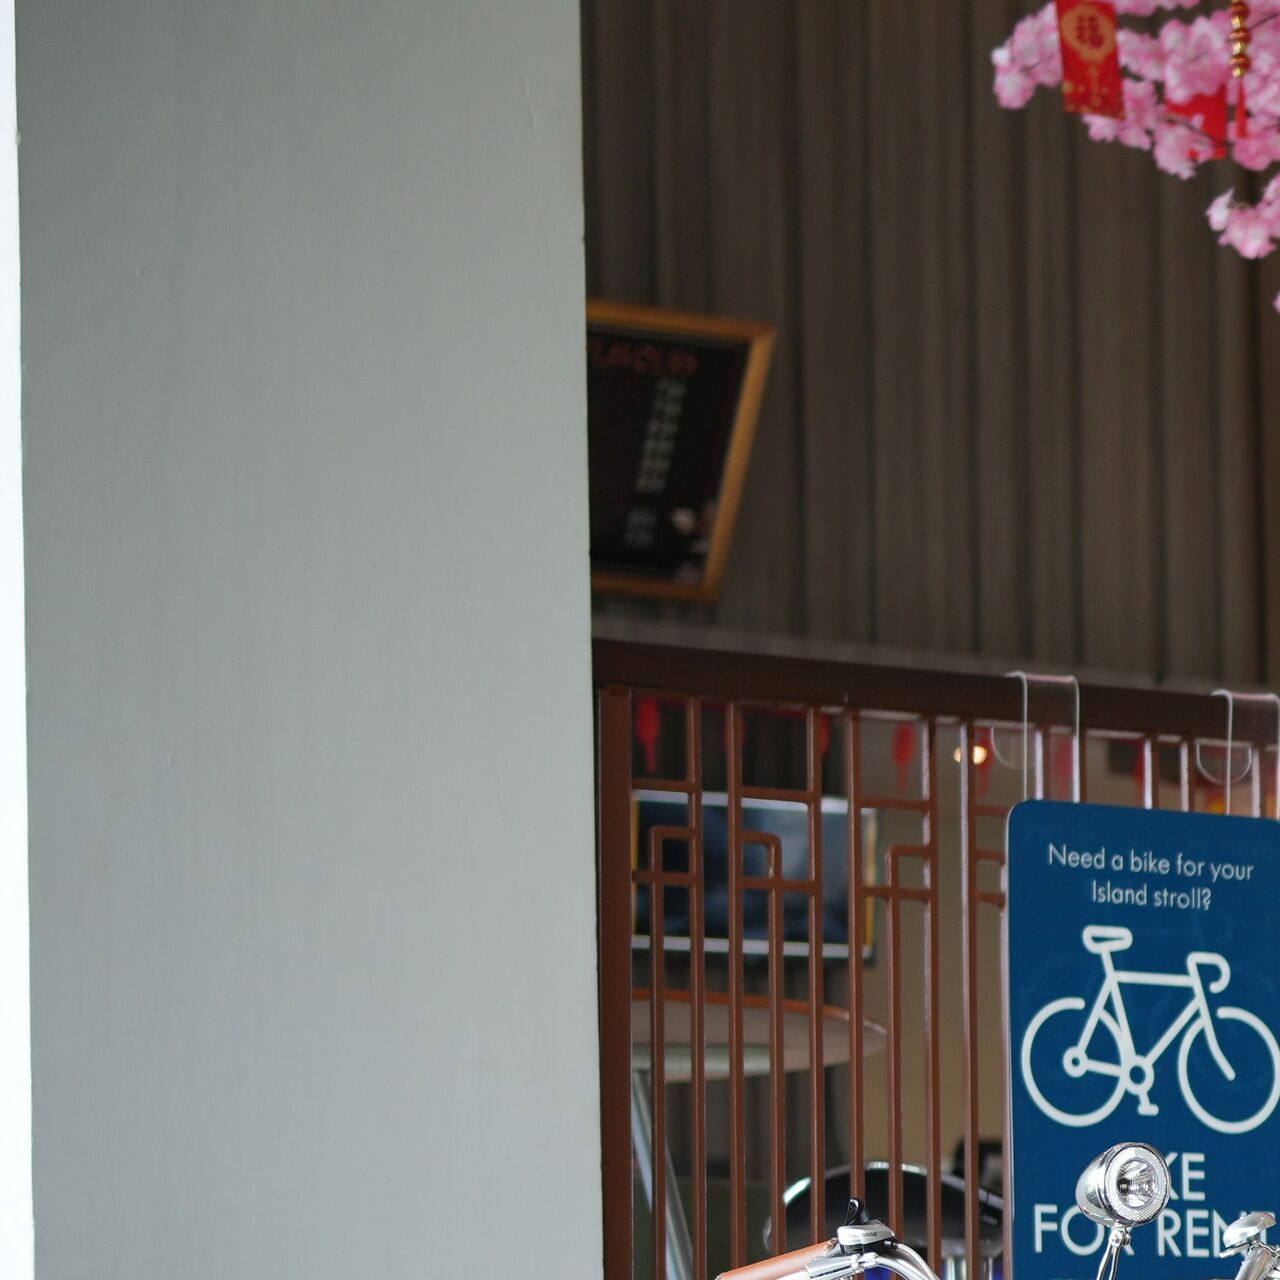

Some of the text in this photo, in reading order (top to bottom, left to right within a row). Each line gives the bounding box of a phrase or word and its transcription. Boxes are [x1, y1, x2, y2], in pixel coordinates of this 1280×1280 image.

[1047, 843, 1255, 883] Need a bike for your
[1092, 879, 1212, 910] Island stroll?
[1034, 1204, 1135, 1257] FO
